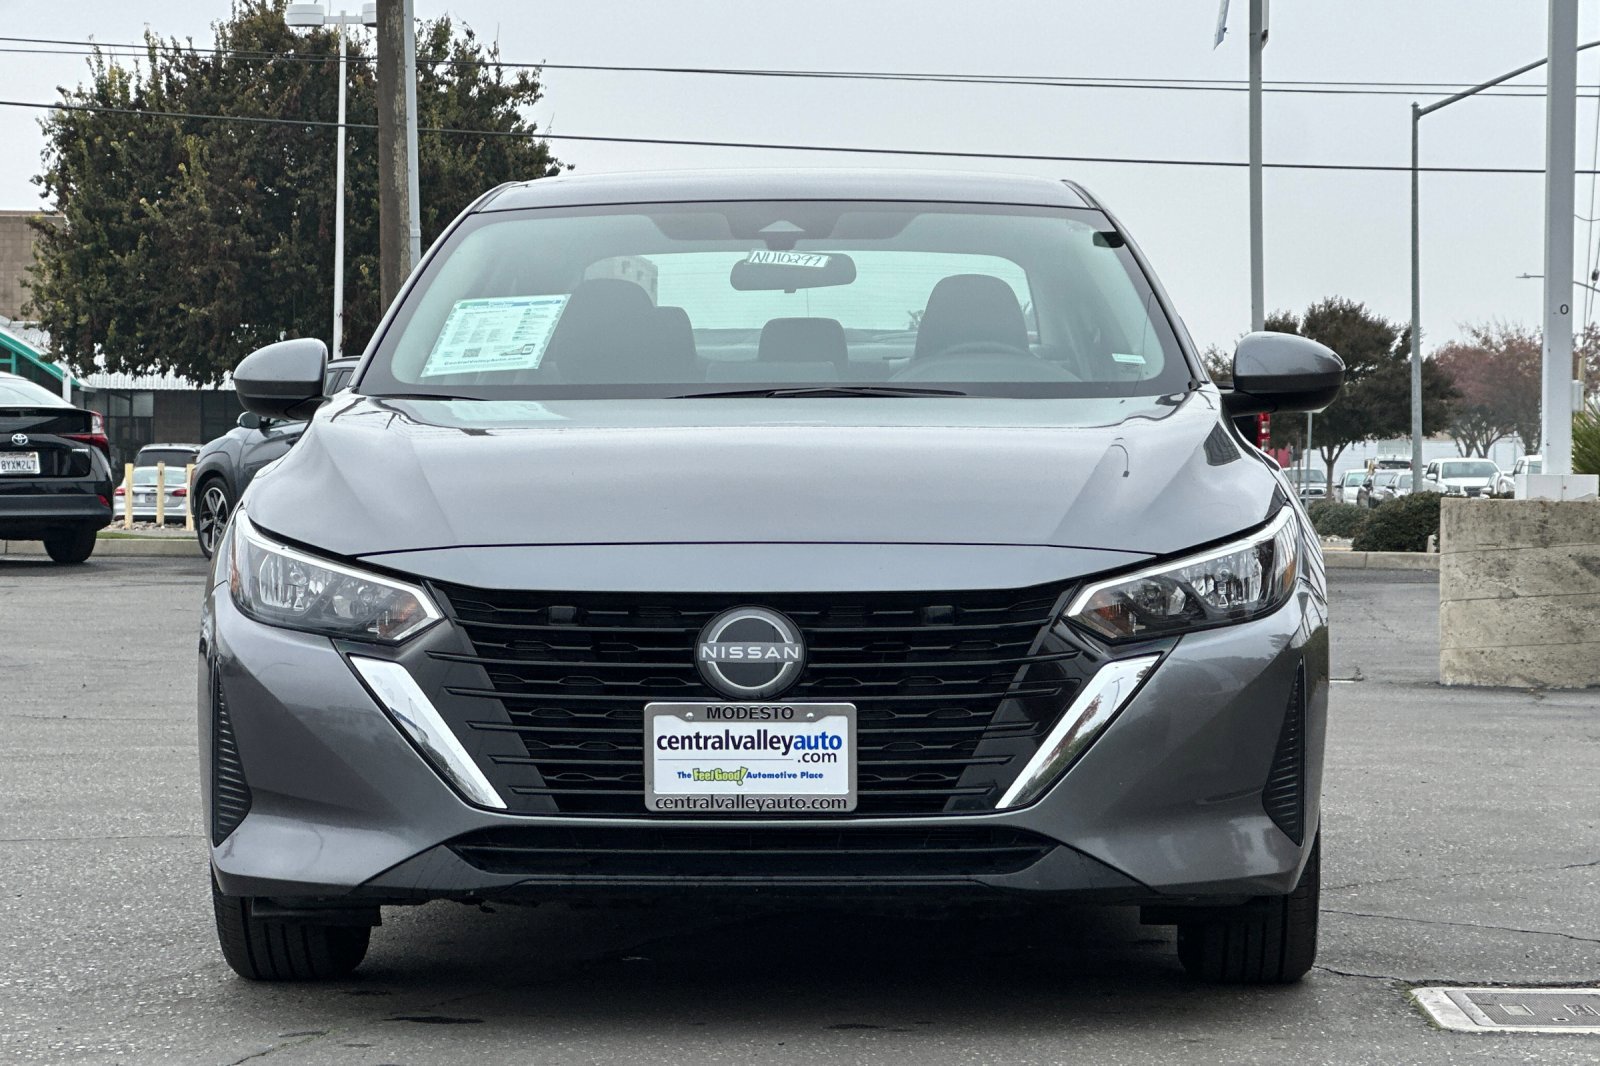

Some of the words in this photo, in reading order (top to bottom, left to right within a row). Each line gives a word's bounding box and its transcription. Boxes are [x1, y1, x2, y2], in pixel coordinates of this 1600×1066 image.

[702, 646, 799, 659] NISSAN
[706, 707, 794, 719] MODESTO
[677, 771, 692, 779] The
[746, 771, 798, 779] Automotive
[800, 771, 824, 779] Place
[655, 794, 848, 811] centralvalleyauto.com
